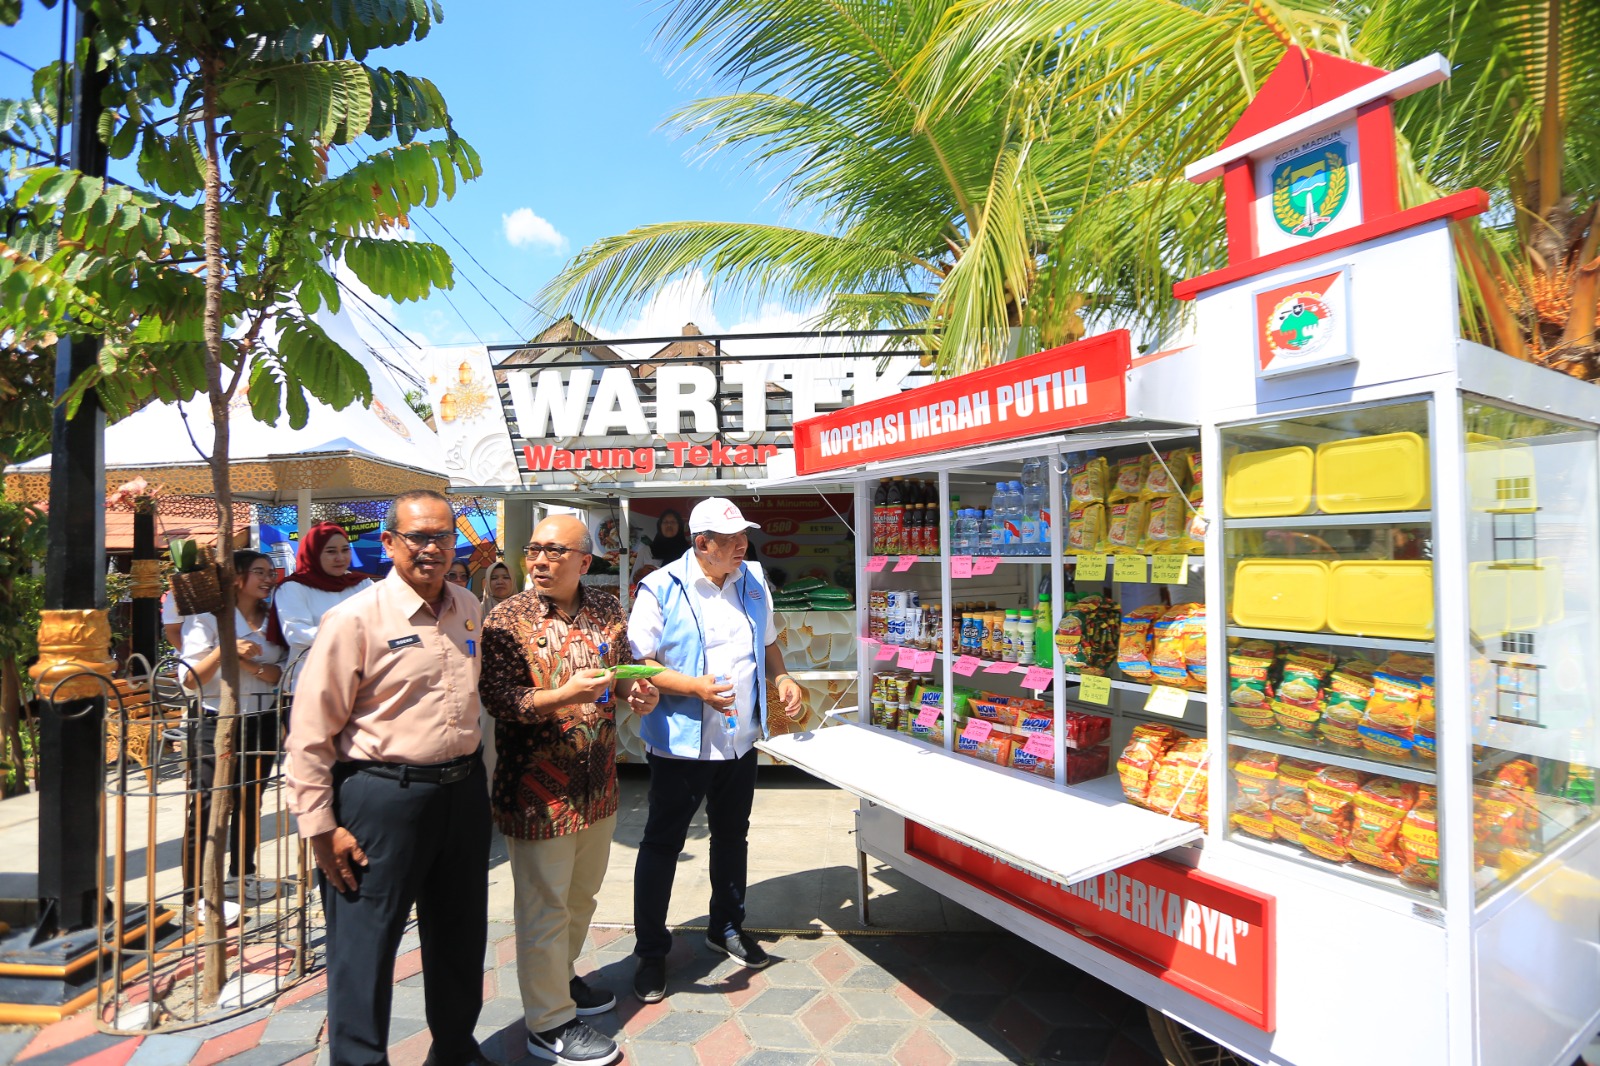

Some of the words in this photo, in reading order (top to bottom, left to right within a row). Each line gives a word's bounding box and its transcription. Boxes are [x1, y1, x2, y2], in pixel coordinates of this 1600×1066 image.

[1275, 147, 1300, 162] KOTA
[1302, 130, 1341, 149] MADIUN
[820, 411, 906, 458] KOPERASI
[910, 390, 991, 441] MERAH
[997, 365, 1088, 422] PUTIH
[523, 444, 655, 474] Warung
[351, 521, 380, 531] PANGAN
[766, 520, 793, 534] 1.500
[766, 542, 792, 555] 1.500
[922, 692, 941, 701] WOW
[987, 696, 1010, 705] WOW
[976, 705, 996, 713] WOW
[1022, 718, 1051, 728] WOW
